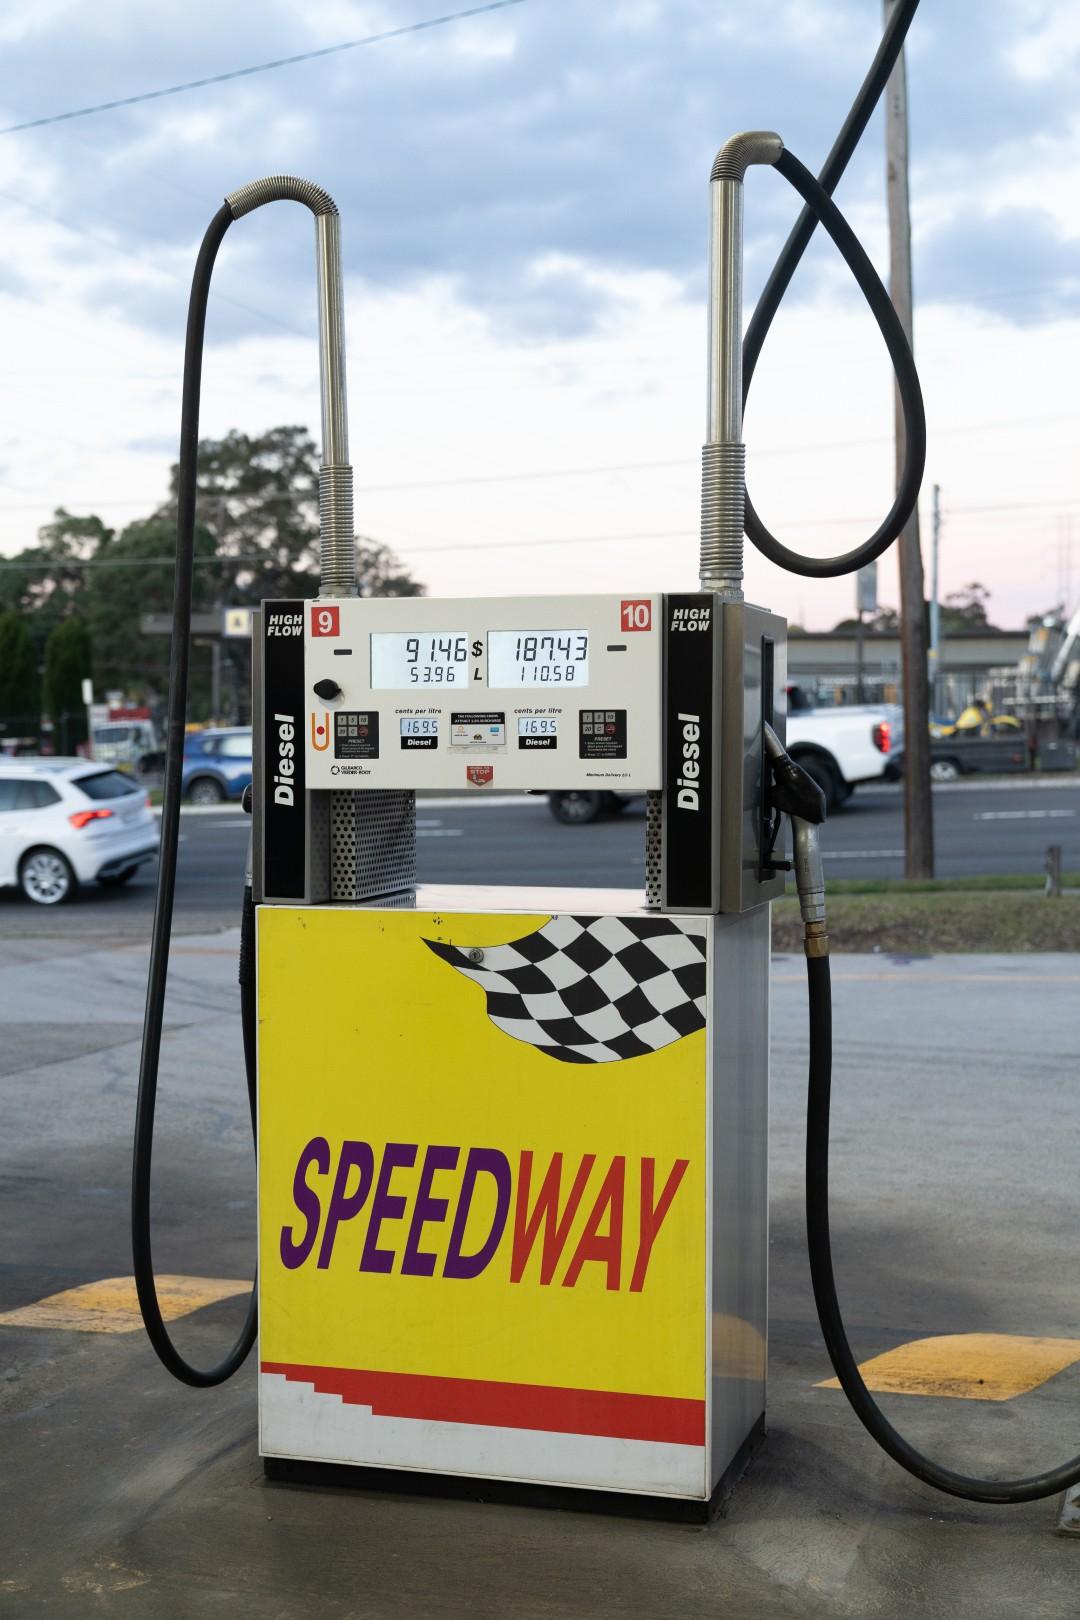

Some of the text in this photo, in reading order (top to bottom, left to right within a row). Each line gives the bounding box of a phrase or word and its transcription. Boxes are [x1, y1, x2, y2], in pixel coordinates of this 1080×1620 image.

[269, 614, 303, 625] HIGH
[318, 610, 333, 633] 9
[623, 604, 649, 628] 10
[673, 608, 710, 619] HIGH
[267, 625, 303, 637] FLOW
[670, 620, 709, 631] FLOW
[406, 638, 468, 663] 91.46
[471, 640, 483, 658] $
[515, 636, 588, 662] 187.43
[410, 666, 456, 683] 53.96
[473, 667, 483, 681] L
[520, 666, 575, 682] 110.58
[407, 720, 438, 733] 169.5
[525, 720, 556, 733] 169.5
[407, 738, 432, 746] Diesel
[525, 738, 550, 746] Diesel
[274, 714, 294, 806] Diesel
[677, 713, 699, 810] Diesel
[279, 1136, 690, 1292] SPEEDWAY
